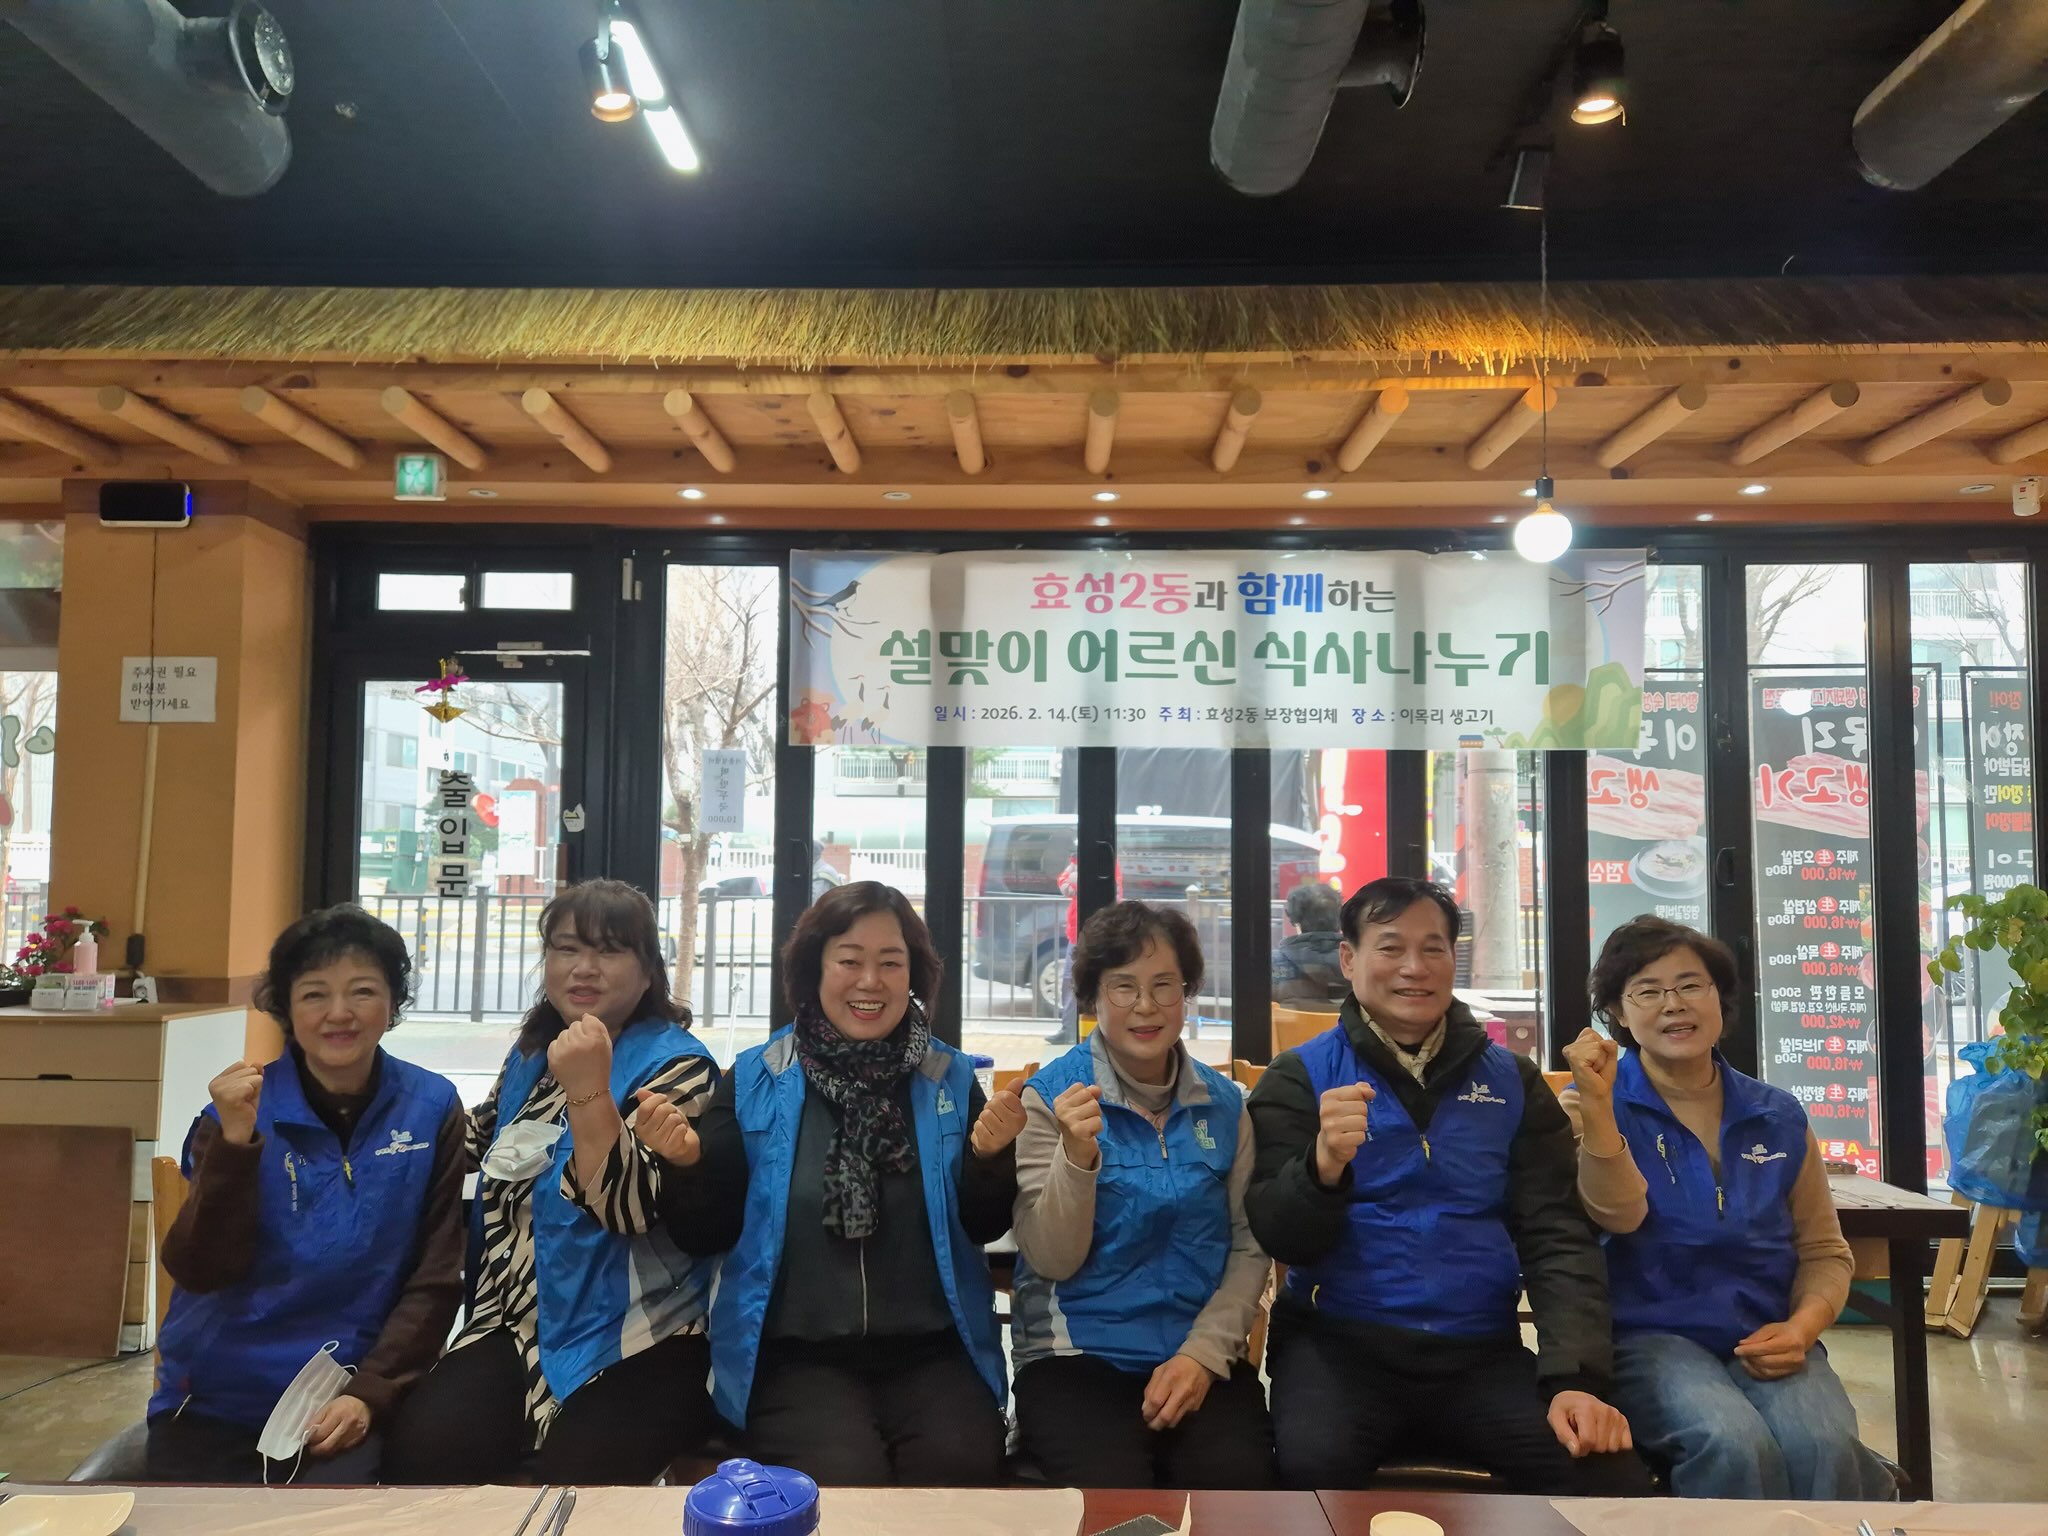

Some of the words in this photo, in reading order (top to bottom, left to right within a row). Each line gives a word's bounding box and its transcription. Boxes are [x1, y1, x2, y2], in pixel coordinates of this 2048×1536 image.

[1030, 572, 1228, 615] 효성2동과
[1237, 571, 1396, 615] 함께하는
[174, 666, 197, 679] 필요
[879, 628, 1048, 686] 설맞이
[1067, 628, 1237, 687] 어르신
[1254, 630, 1549, 687] 식사나누기
[981, 707, 1023, 721] 2026.
[1028, 707, 1042, 721] 2.
[1047, 706, 1099, 723] 14.(토)
[1103, 707, 1146, 722] 11:30
[1205, 706, 1259, 724] 효성2동
[1263, 706, 1338, 724] 보장협의체
[1400, 708, 1444, 725] 이목리
[1449, 708, 1494, 726] 생고기
[436, 772, 471, 898] 출입문
